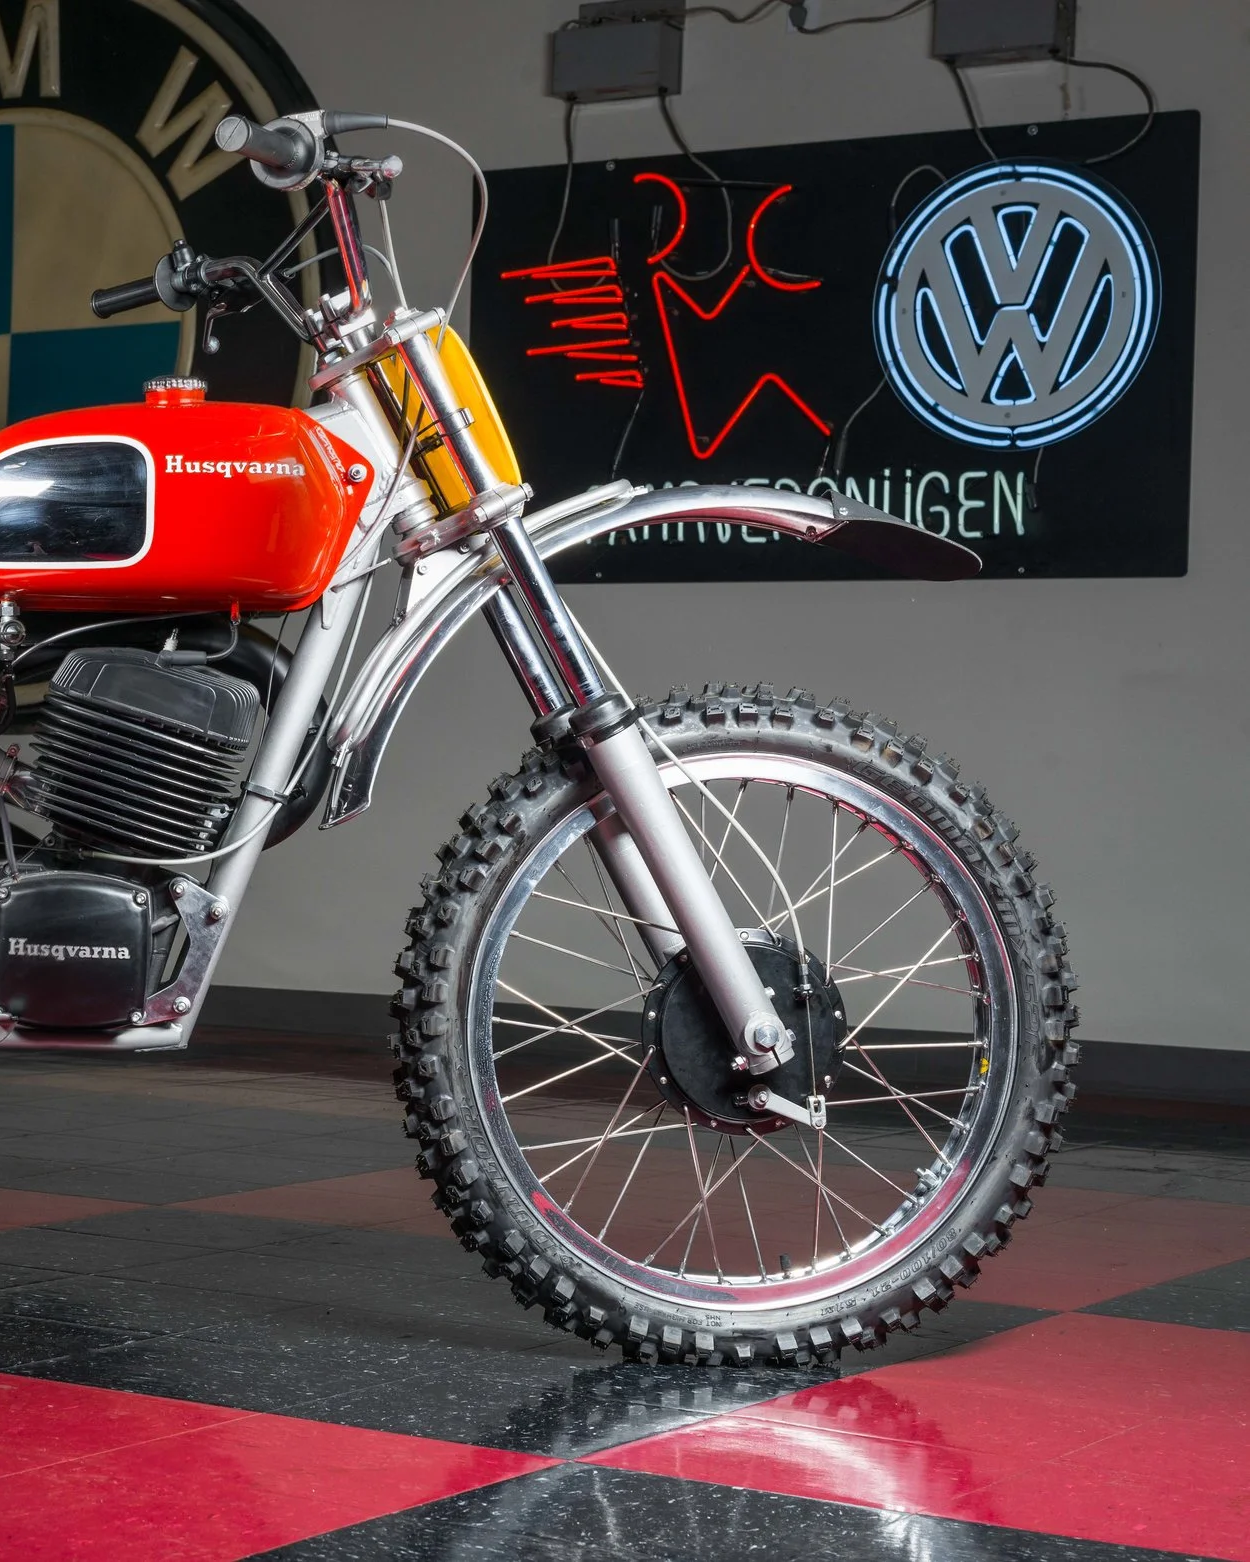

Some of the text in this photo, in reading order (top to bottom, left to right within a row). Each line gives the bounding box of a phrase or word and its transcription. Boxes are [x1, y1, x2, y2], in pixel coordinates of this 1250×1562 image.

[164, 454, 305, 478] Husqvarna
[8, 937, 130, 960] Husqvarna
[459, 1104, 558, 1254] DUNLOP
[868, 1226, 958, 1298] 80/100-21
